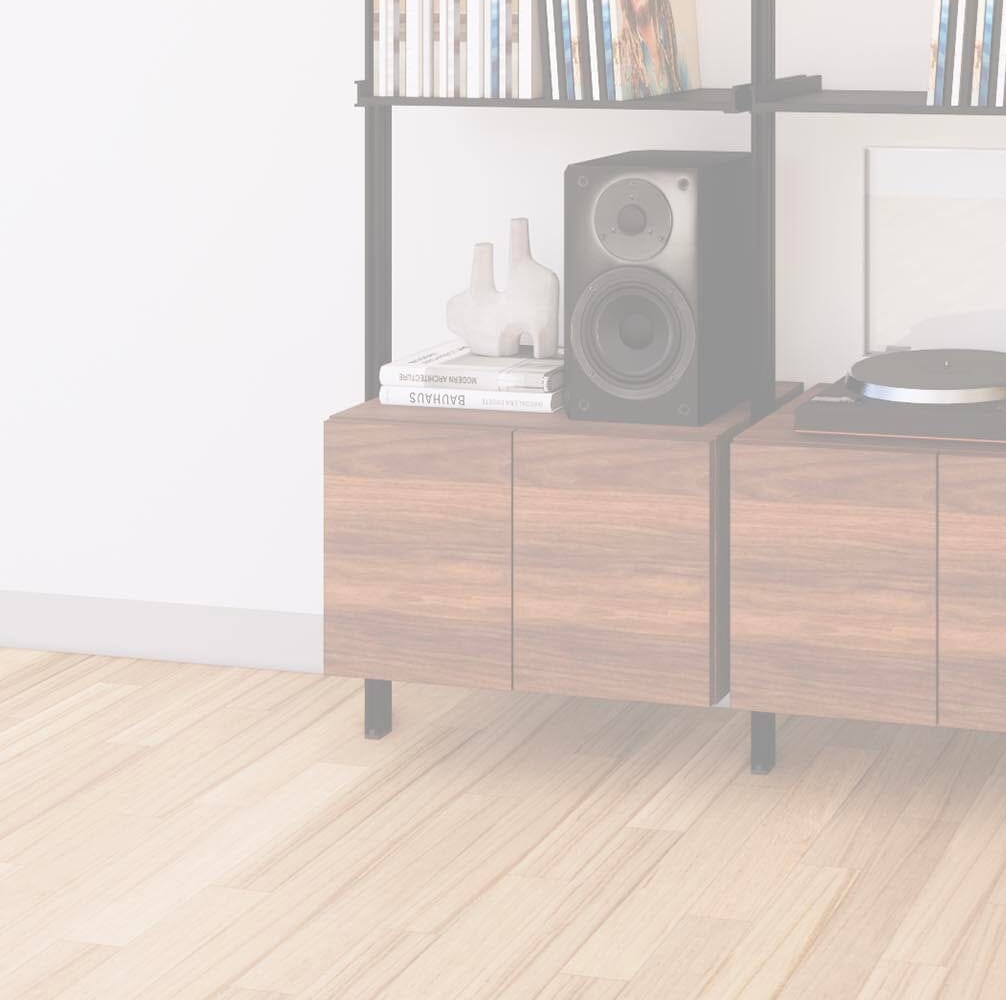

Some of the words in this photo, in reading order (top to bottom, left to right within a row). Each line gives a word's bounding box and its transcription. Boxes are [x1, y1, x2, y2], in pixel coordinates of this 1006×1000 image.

[400, 372, 448, 384] ARCHITECTURE
[448, 375, 478, 385] MODERN
[409, 391, 466, 406] BAUHAUS
